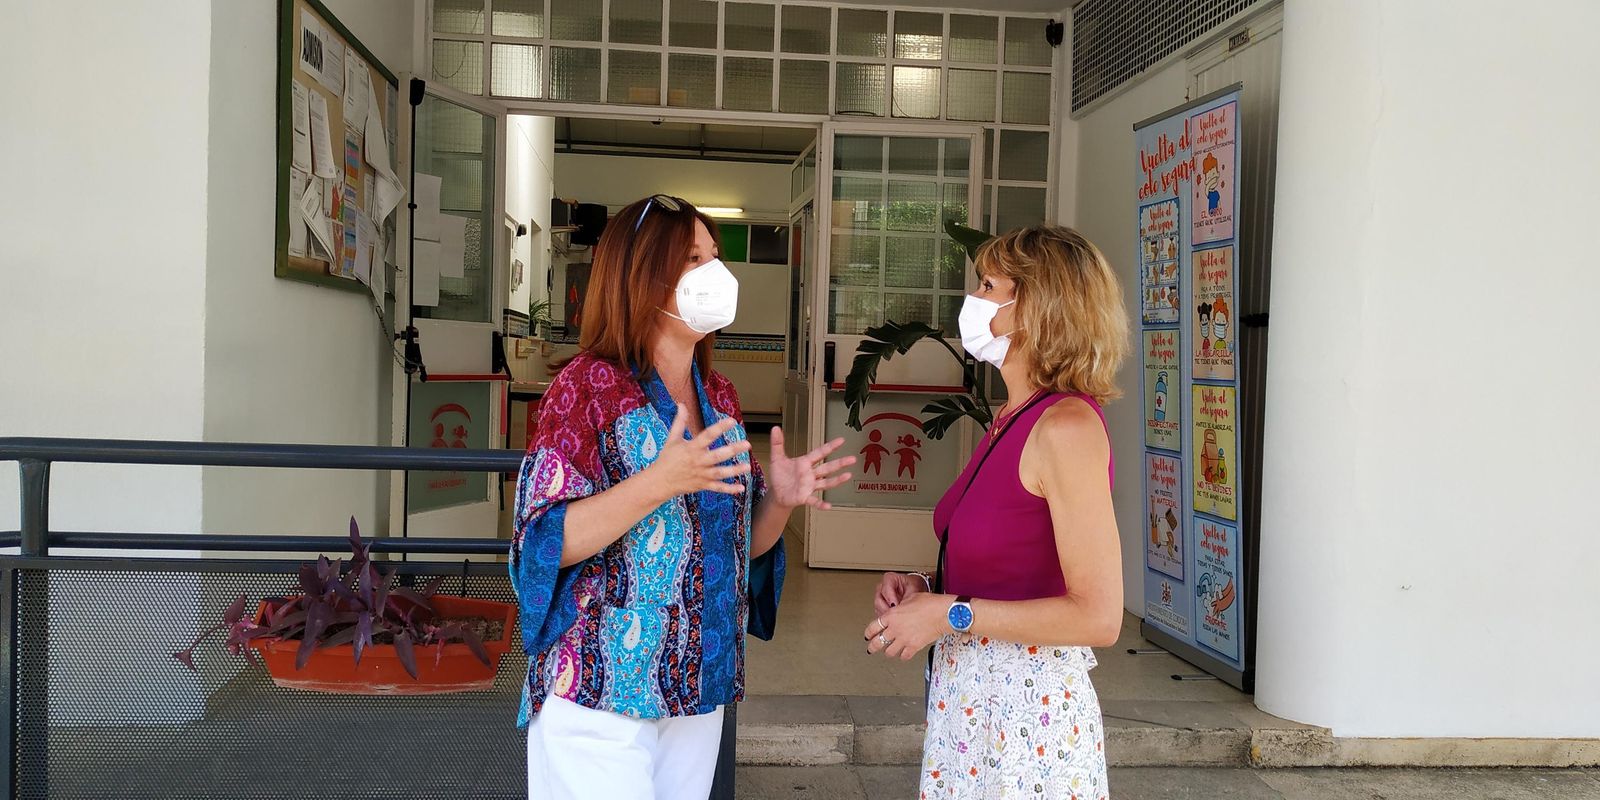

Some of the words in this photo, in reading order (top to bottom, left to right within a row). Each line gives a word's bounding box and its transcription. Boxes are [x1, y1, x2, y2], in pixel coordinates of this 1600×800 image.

[1200, 113, 1217, 130] Vuelta
[1220, 109, 1226, 124] al
[1197, 130, 1208, 144] cole
[1209, 128, 1227, 146] segura
[1141, 133, 1175, 173] Vuelta
[1179, 119, 1190, 151] al
[1139, 169, 1158, 200] cole
[1161, 156, 1196, 196] segura
[1166, 203, 1171, 216] al
[1201, 210, 1207, 219] EL
[1220, 251, 1225, 265] al
[1168, 332, 1173, 346] al
[1195, 349, 1201, 357] LA
[1202, 389, 1217, 404] Vuelta
[1219, 389, 1226, 404] al
[1210, 407, 1229, 423] segura
[1169, 460, 1175, 473] al
[1197, 480, 1204, 489] NO
[1205, 481, 1211, 490] TE
[1203, 523, 1219, 540] Vuelta
[1221, 528, 1226, 543] al
